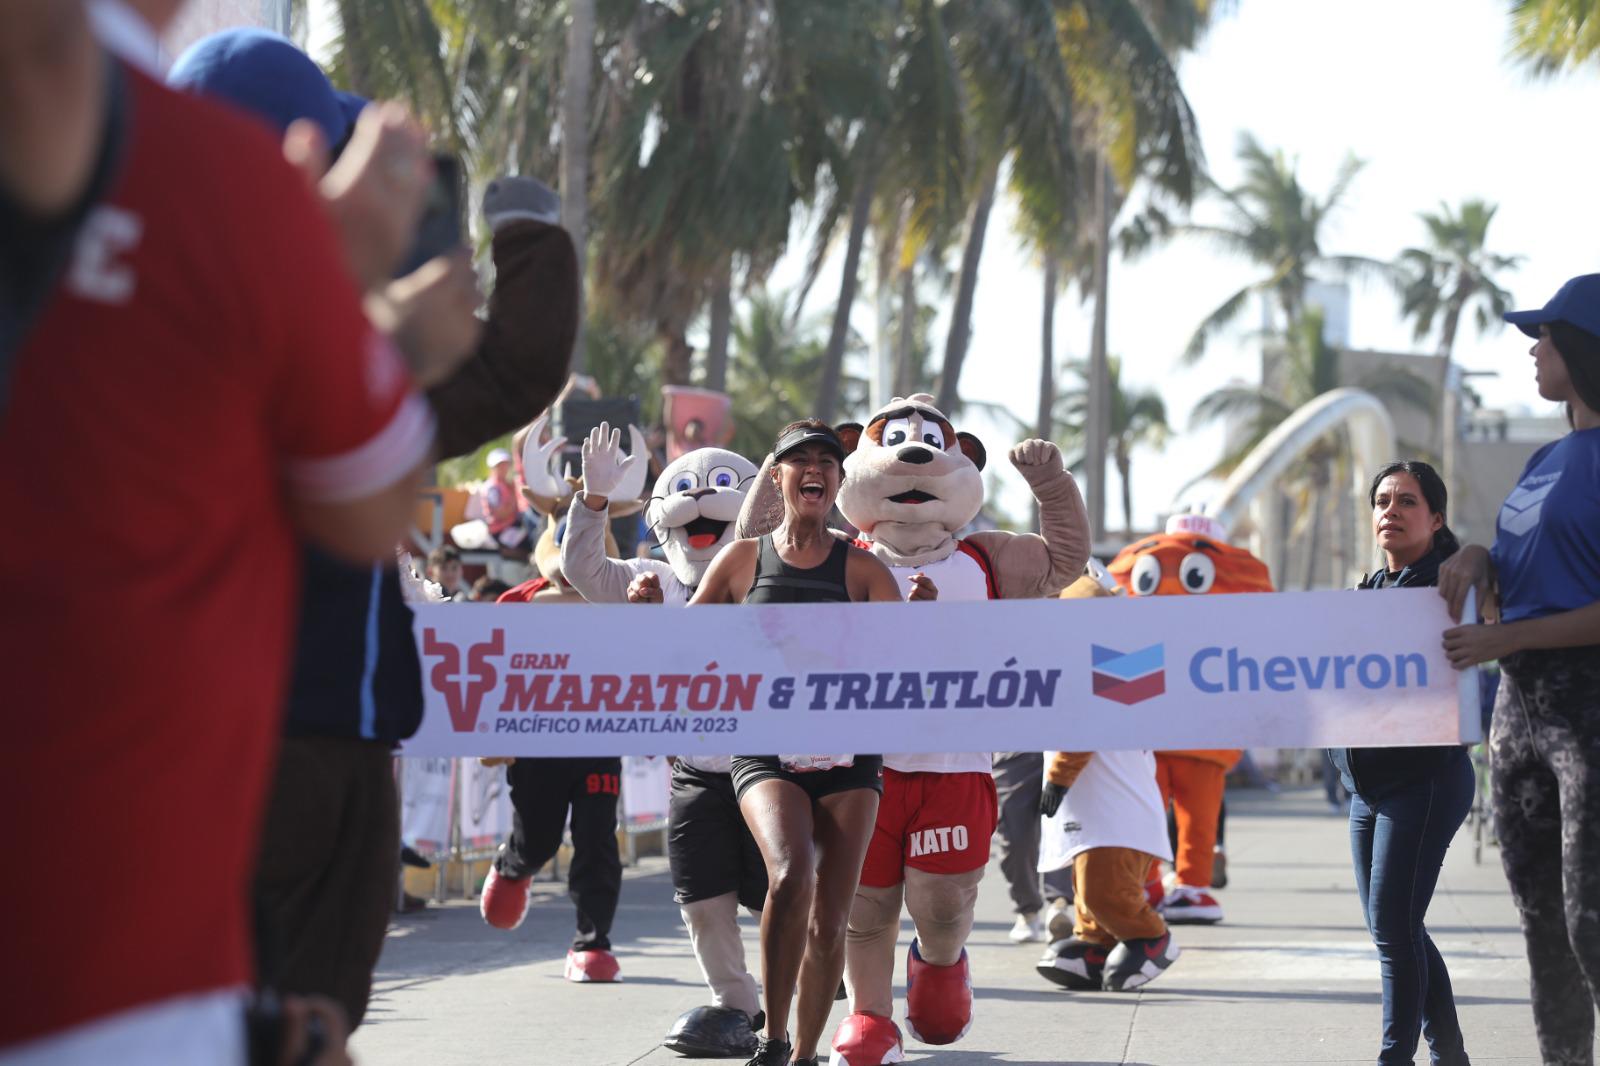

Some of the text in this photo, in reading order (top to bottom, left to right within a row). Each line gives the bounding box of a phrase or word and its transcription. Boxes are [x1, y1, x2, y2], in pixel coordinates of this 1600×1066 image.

[509, 653, 571, 670] GRAN
[1188, 646, 1428, 694] Chevron
[498, 656, 1062, 712] MARATÓN & TRIATLÓN
[494, 714, 738, 734] PACÍFICO MAZATLÁN 2023
[909, 825, 969, 859] KATO
